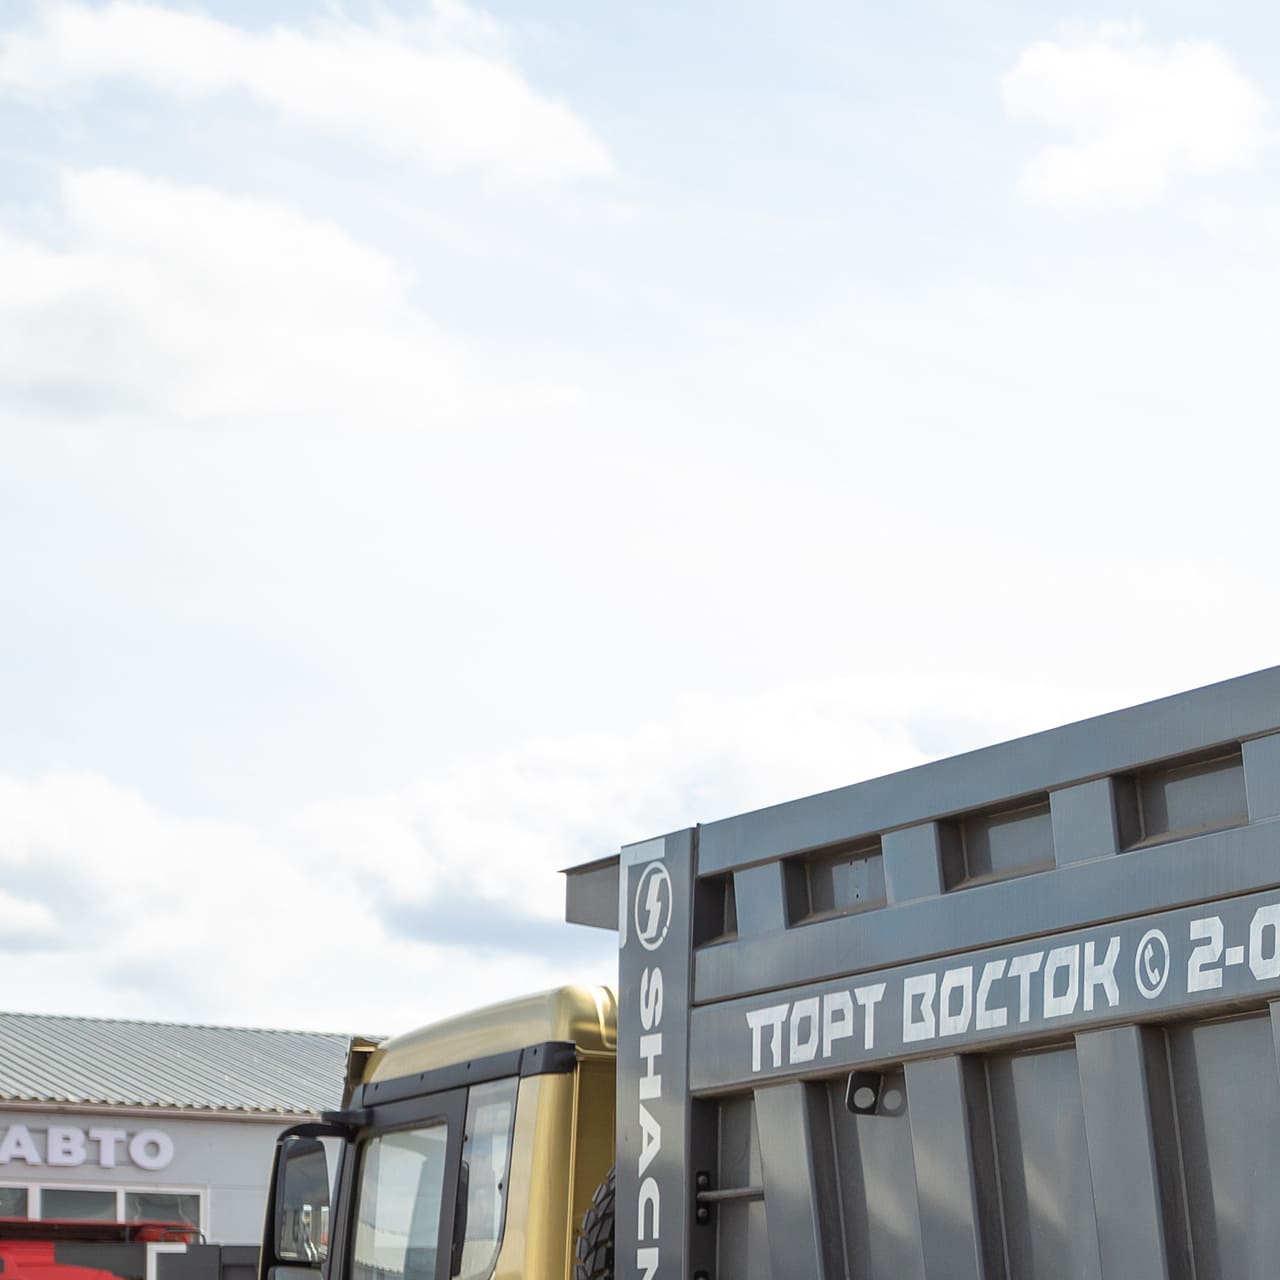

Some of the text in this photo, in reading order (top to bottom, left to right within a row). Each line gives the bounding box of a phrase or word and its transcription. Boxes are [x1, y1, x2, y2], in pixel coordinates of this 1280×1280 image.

[745, 982, 887, 1073] ПОРТ
[902, 935, 1121, 1044] ВОСТОК
[0, 1124, 175, 1171] АВТО
